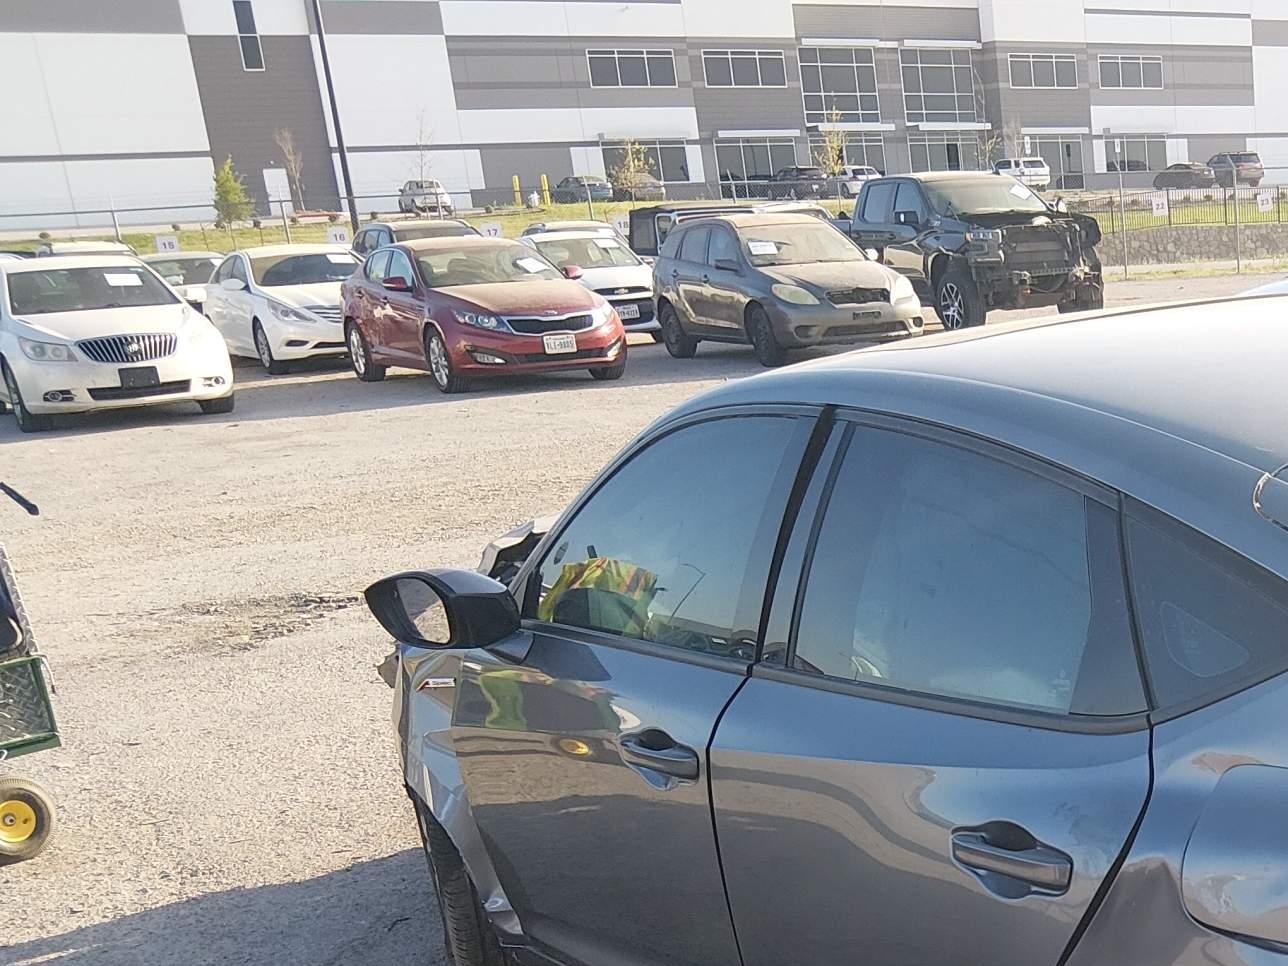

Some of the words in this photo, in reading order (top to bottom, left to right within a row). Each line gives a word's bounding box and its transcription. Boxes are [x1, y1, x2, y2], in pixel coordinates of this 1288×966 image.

[334, 233, 346, 241] 16
[487, 228, 498, 237] 17
[162, 241, 175, 250] 15
